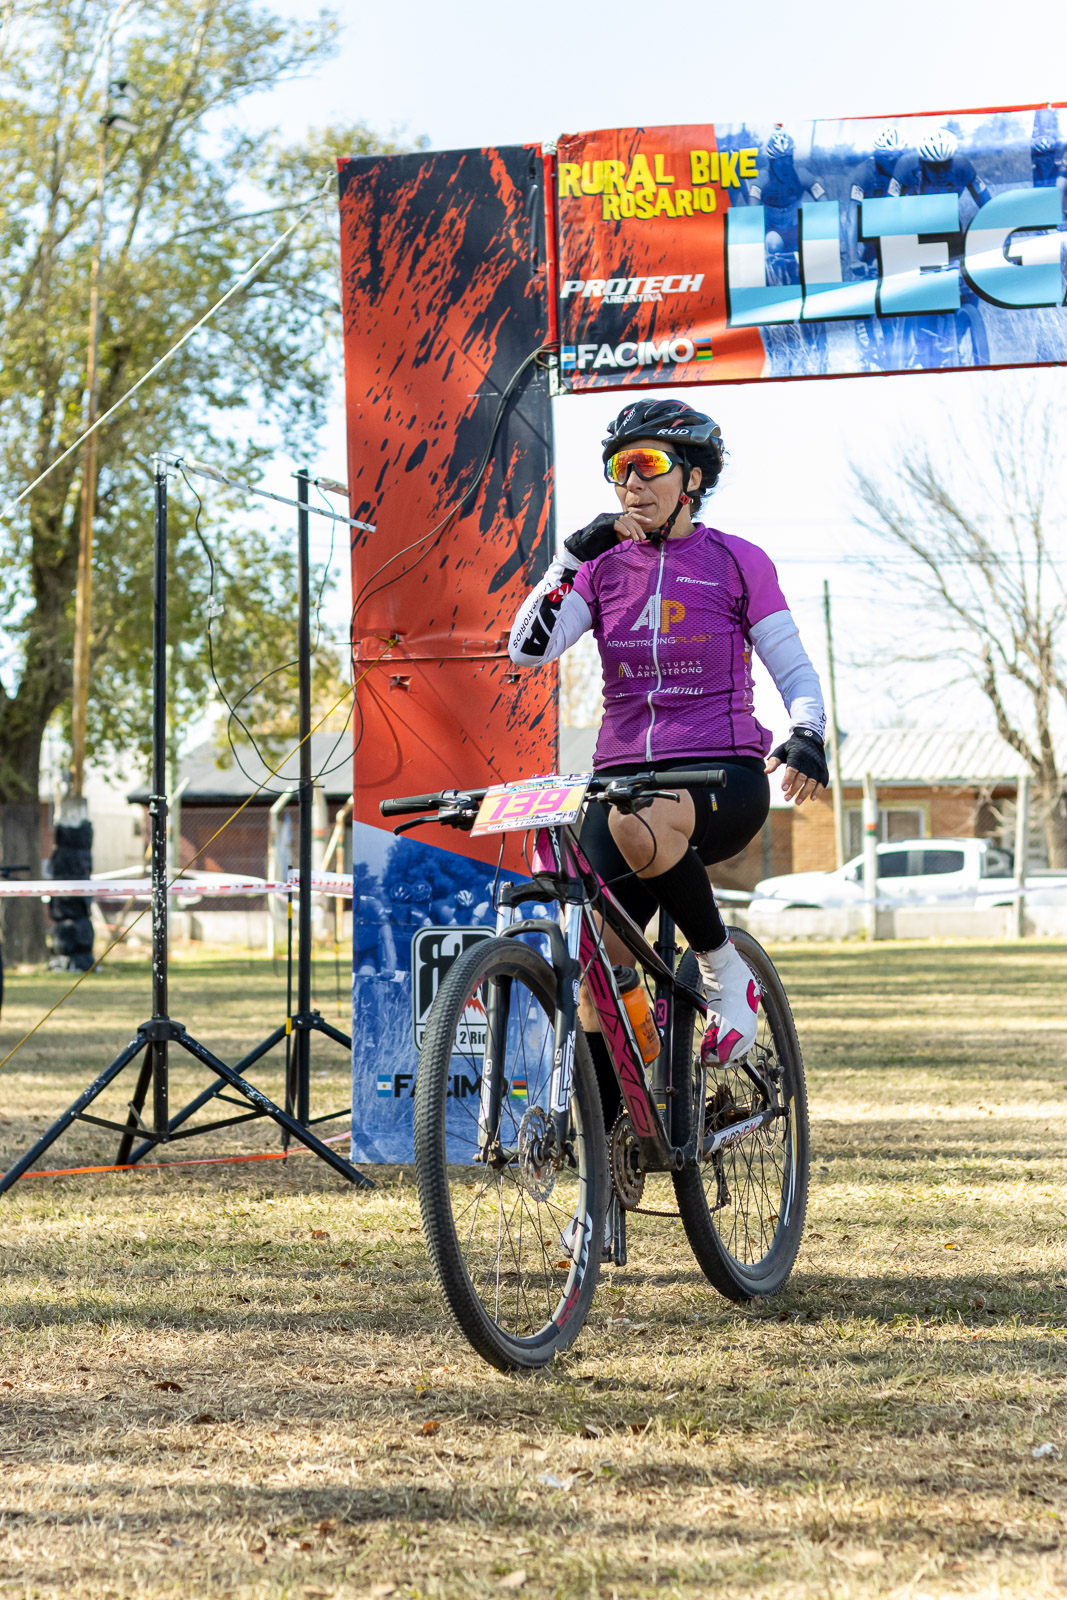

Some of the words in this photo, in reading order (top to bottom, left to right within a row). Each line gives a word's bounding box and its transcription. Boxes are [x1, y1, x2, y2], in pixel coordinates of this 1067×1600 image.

[558, 153, 675, 198] RURAL
[690, 147, 759, 189] BIKE
[602, 187, 717, 221] ROSARIO
[725, 186, 1067, 328] LLEG
[559, 273, 705, 299] PROTECH
[600, 293, 663, 305] ARGENTINA
[577, 338, 695, 369] FACIMO
[636, 667, 703, 678] ARMSTRONG
[489, 788, 572, 821] 139
[394, 1073, 508, 1099] FIM
